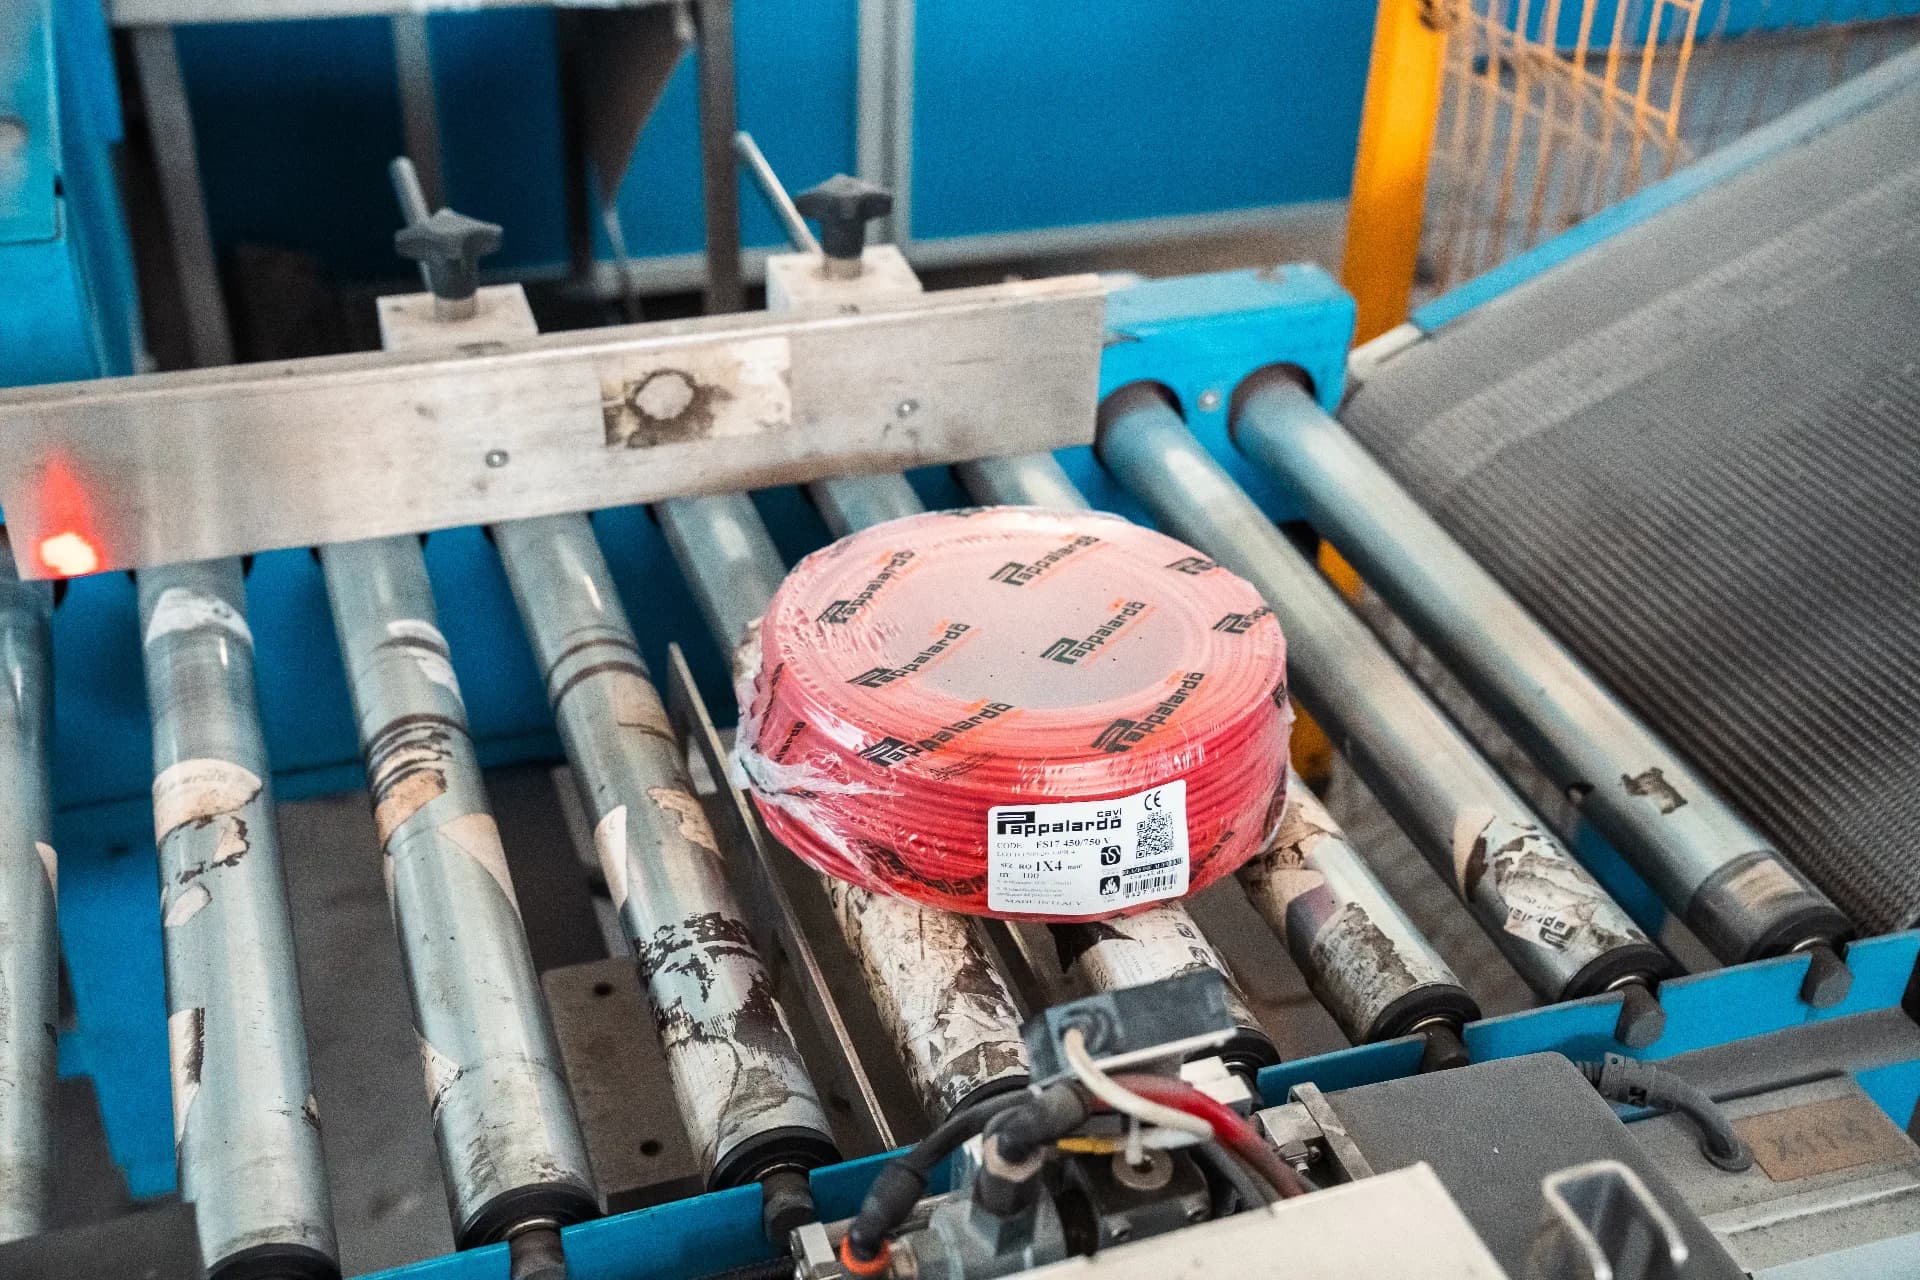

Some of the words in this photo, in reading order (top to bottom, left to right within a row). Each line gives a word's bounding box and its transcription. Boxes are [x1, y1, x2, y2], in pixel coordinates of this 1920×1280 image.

[1097, 808, 1122, 818] cavi
[1063, 838, 1101, 848] 450/750
[1036, 860, 1063, 872] 1X4
